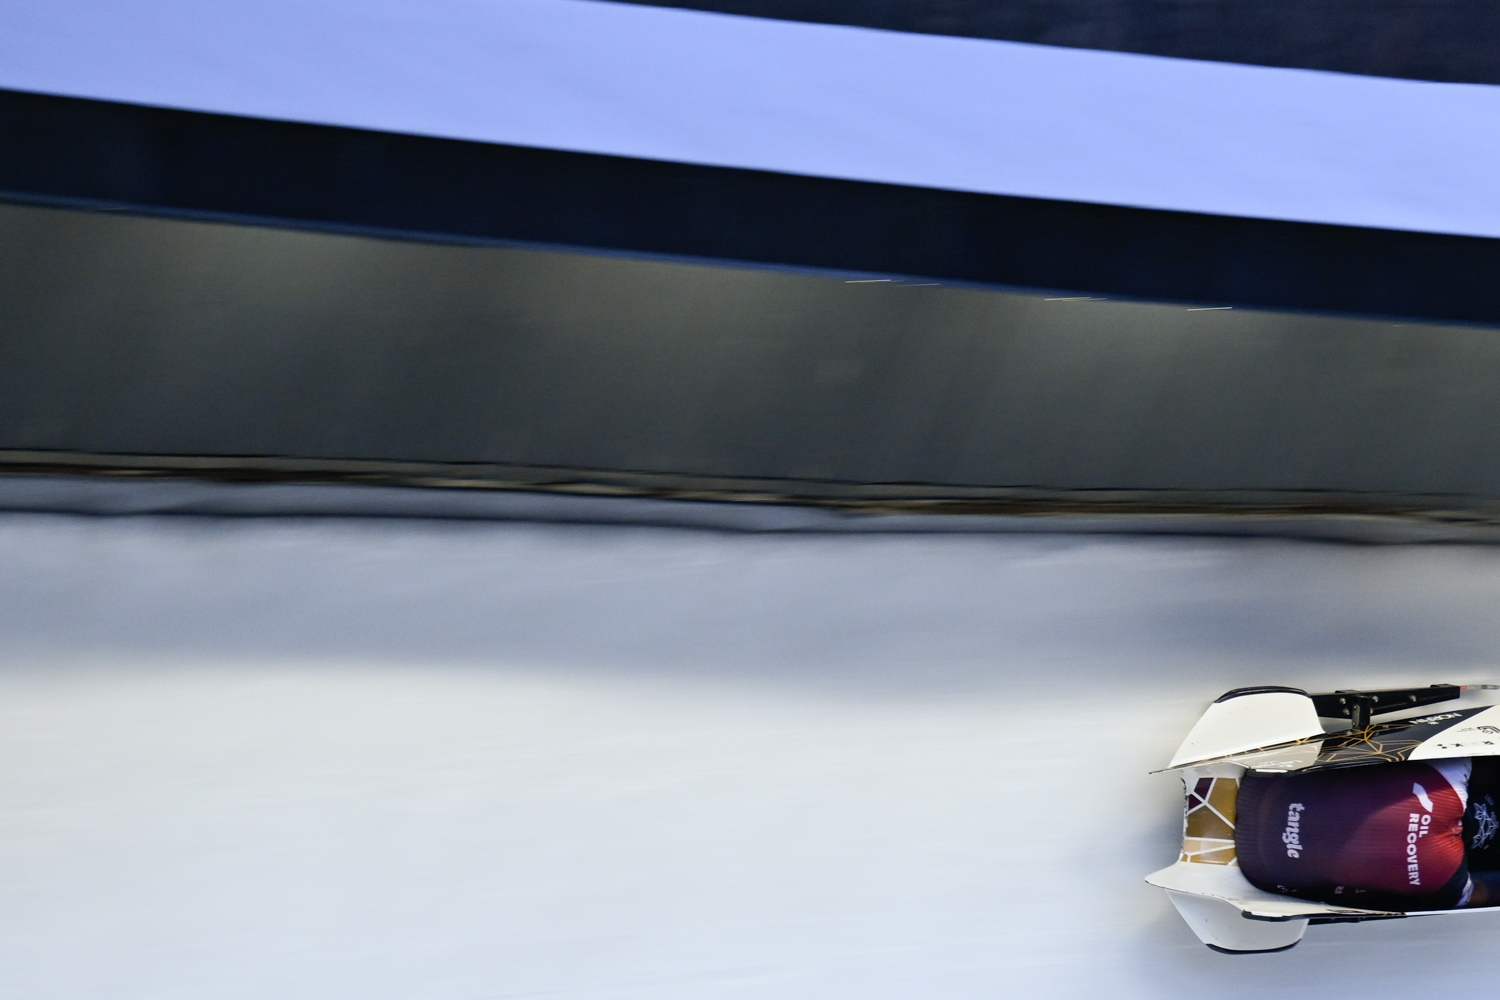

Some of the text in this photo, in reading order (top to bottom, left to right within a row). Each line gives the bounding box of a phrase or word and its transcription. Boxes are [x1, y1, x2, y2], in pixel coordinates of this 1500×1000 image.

[1282, 802, 1306, 859] tangle
[1406, 813, 1421, 886] RECOVERY
[1418, 814, 1432, 838] OIL
